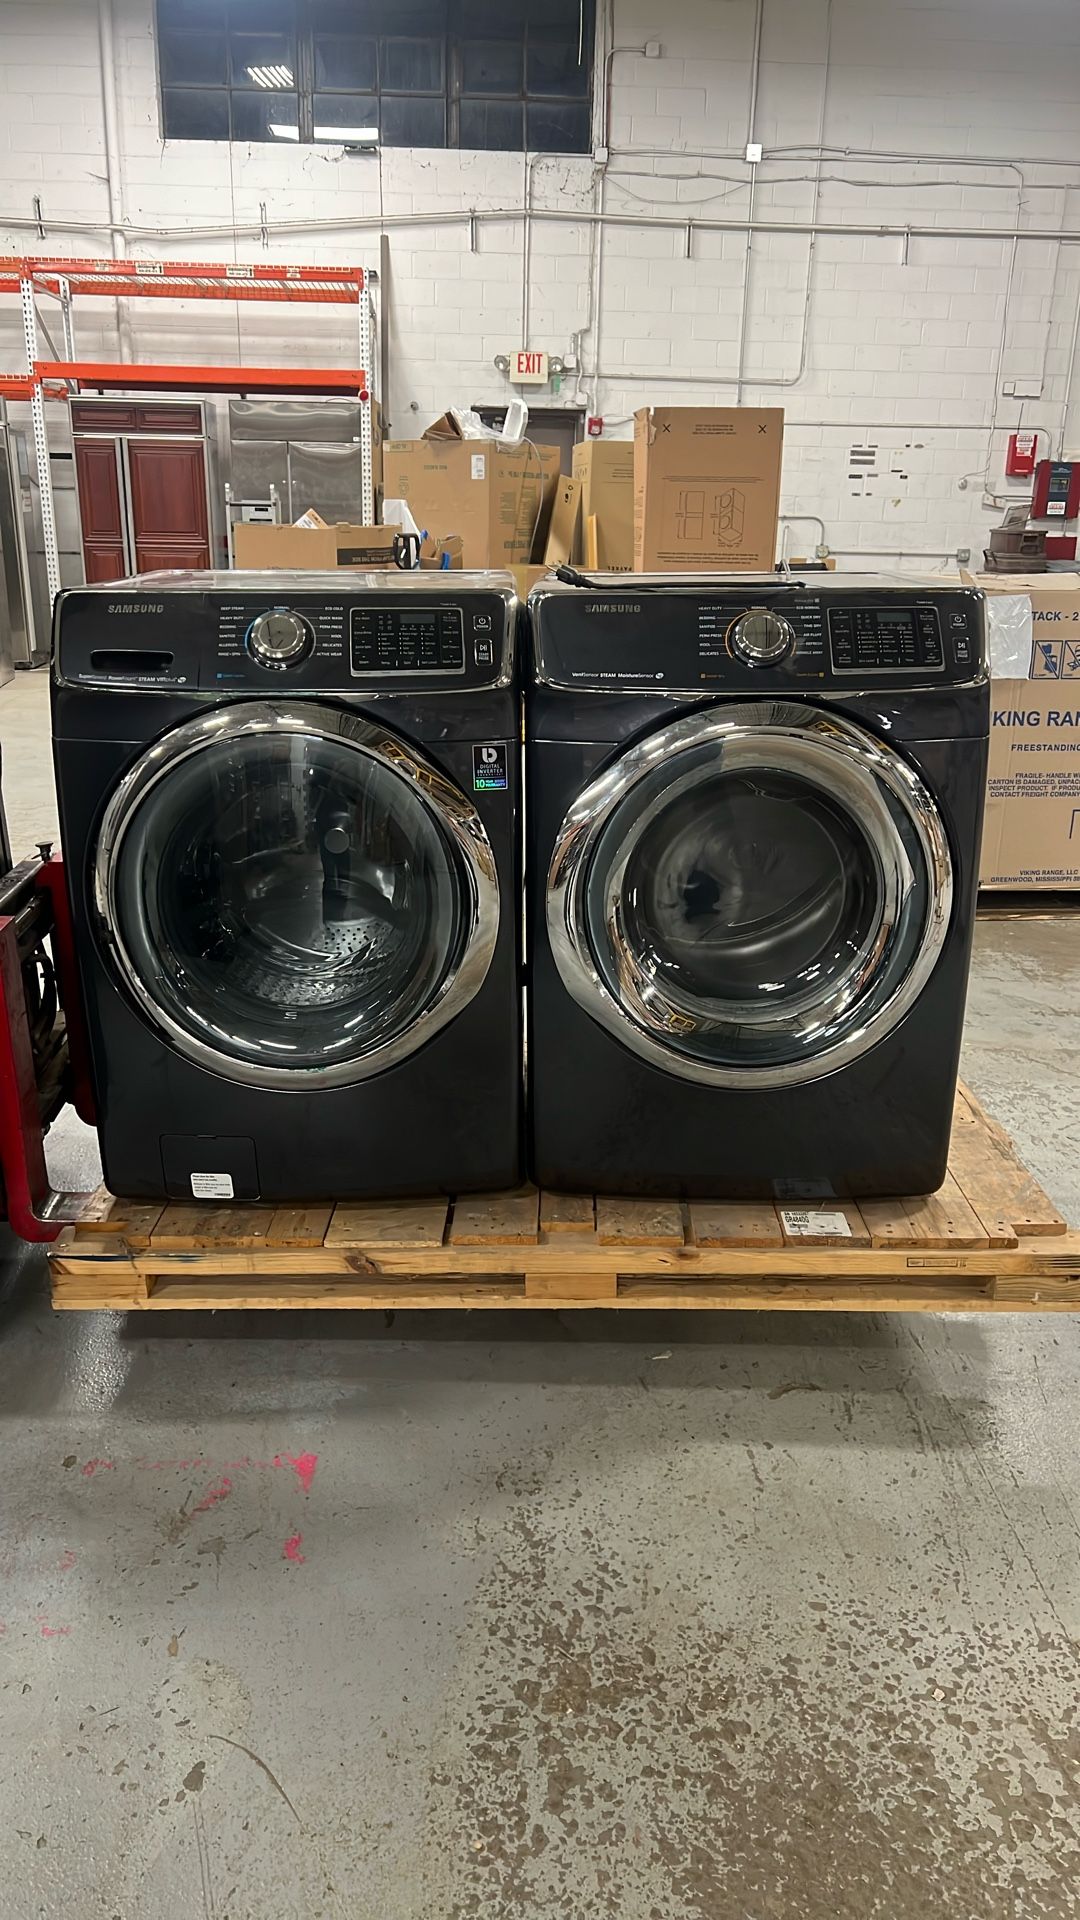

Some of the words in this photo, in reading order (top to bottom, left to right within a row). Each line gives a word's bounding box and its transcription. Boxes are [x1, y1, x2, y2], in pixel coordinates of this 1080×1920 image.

[518, 354, 543, 374] EXIT
[108, 604, 164, 614] SAMSUNG
[584, 604, 641, 613] SAMSUNG
[1032, 612, 1062, 620] TACK
[1072, 612, 1079, 620] 2
[992, 710, 1040, 726] KING
[476, 779, 485, 788] 10
